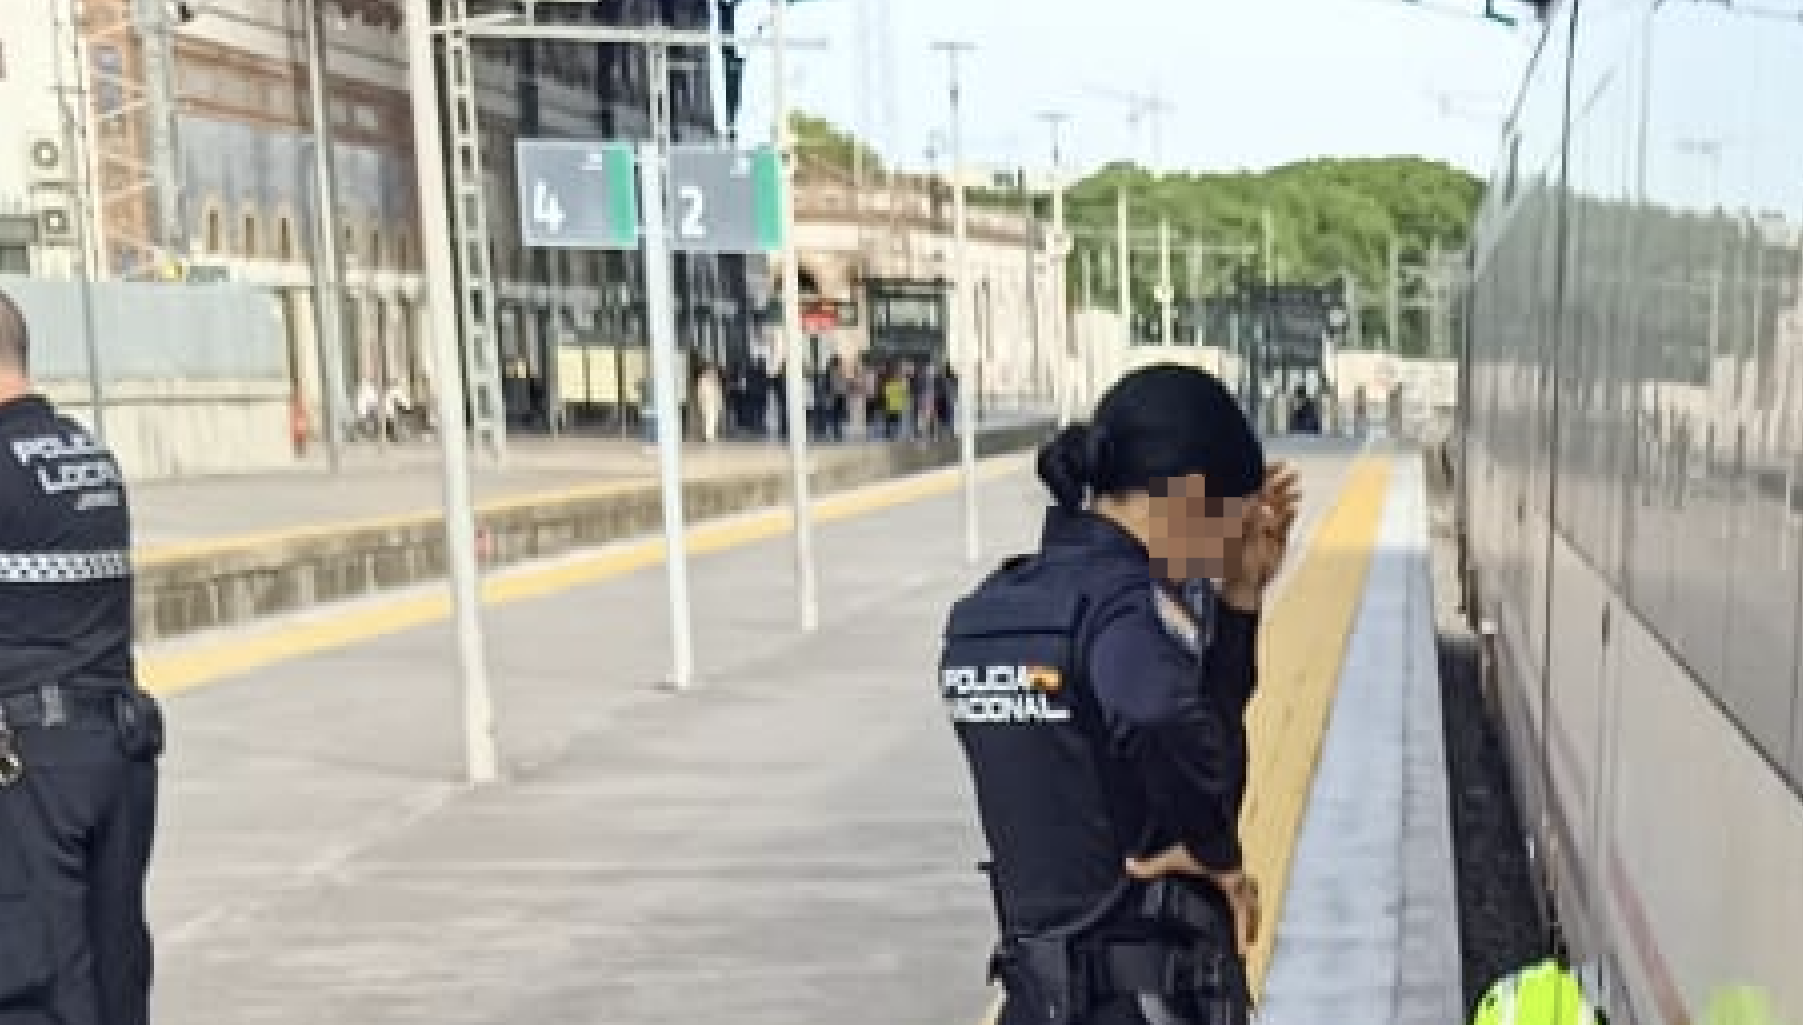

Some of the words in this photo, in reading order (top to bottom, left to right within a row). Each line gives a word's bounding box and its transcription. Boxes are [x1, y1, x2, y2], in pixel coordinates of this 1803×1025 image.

[533, 180, 567, 235] 4
[680, 185, 707, 238] 2
[38, 459, 119, 494] LOCA
[952, 692, 1072, 723] ACIONAL
